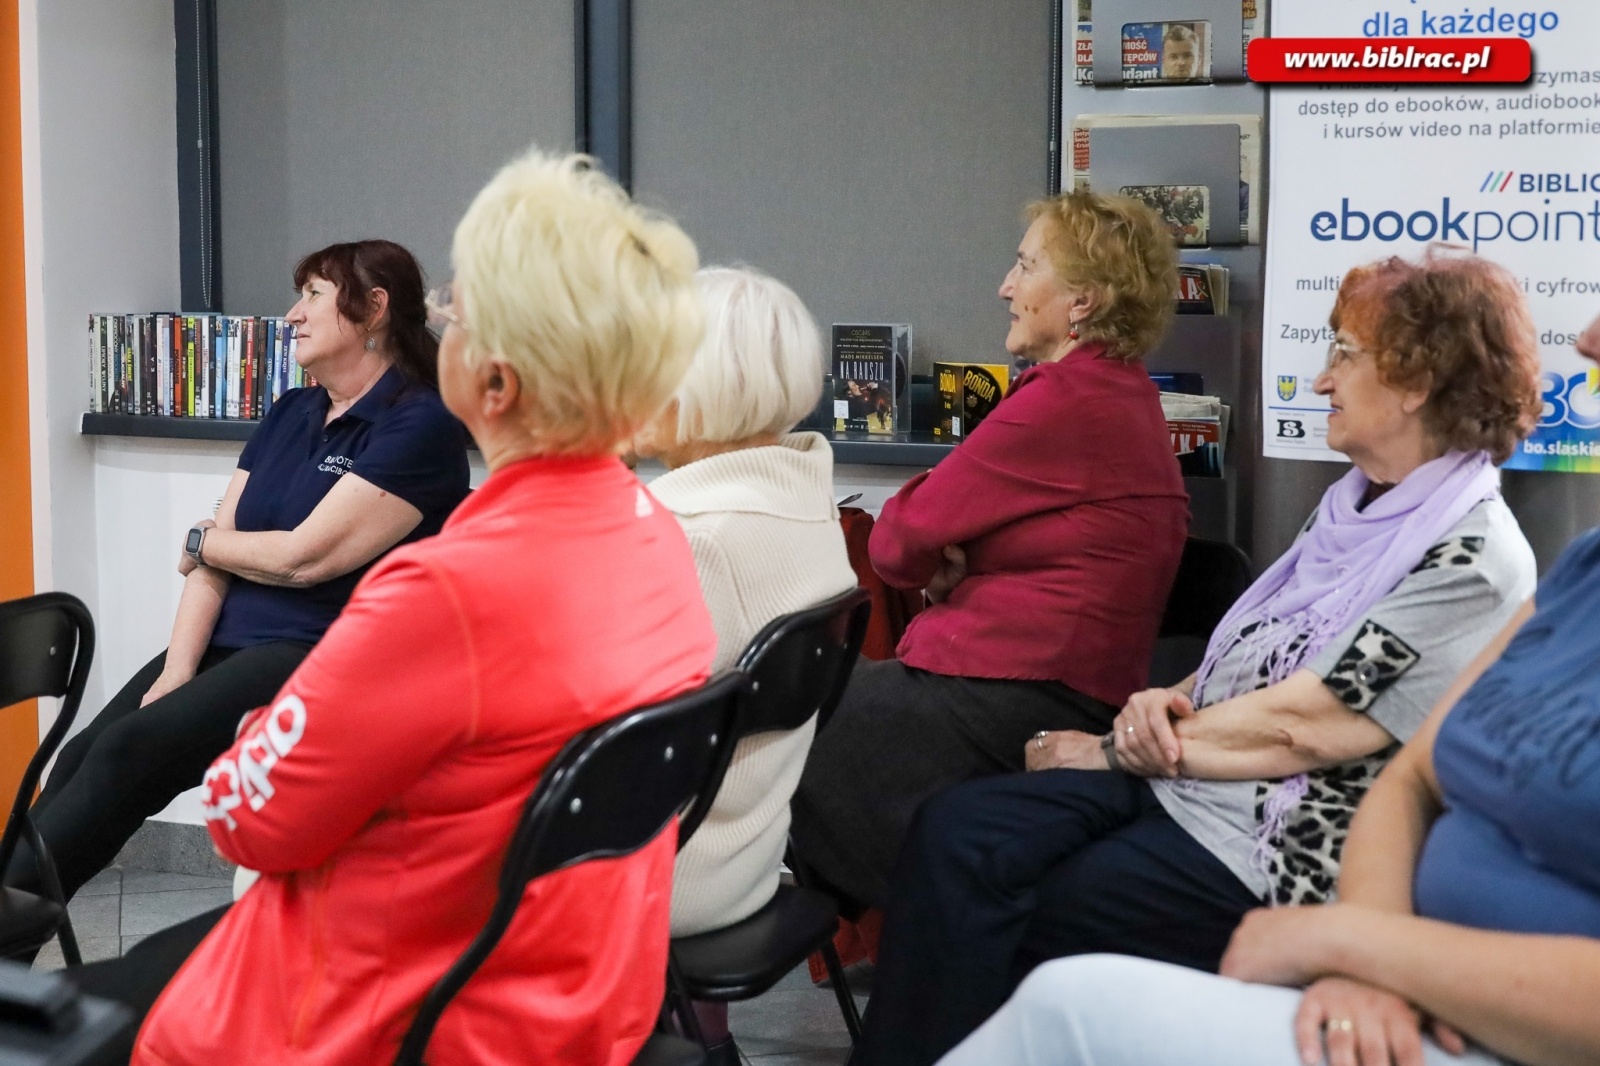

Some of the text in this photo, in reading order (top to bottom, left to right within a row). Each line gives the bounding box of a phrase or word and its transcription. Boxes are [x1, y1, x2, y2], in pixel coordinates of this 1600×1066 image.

[1362, 7, 1560, 39] dla każdego
[1122, 51, 1158, 64] TĘPCÓW
[1535, 70, 1600, 88] zymas
[1298, 99, 1359, 118] dostęp
[1365, 97, 1389, 113] do
[1395, 95, 1489, 113] ebooków,
[1323, 117, 1600, 140] i kursów video na platformie
[1310, 196, 1600, 254] ebookpoint
[1296, 275, 1340, 291] multi
[1536, 277, 1600, 298] cyfrow
[1280, 324, 1578, 346] Zapyta dos
[963, 369, 996, 403] BONDA
